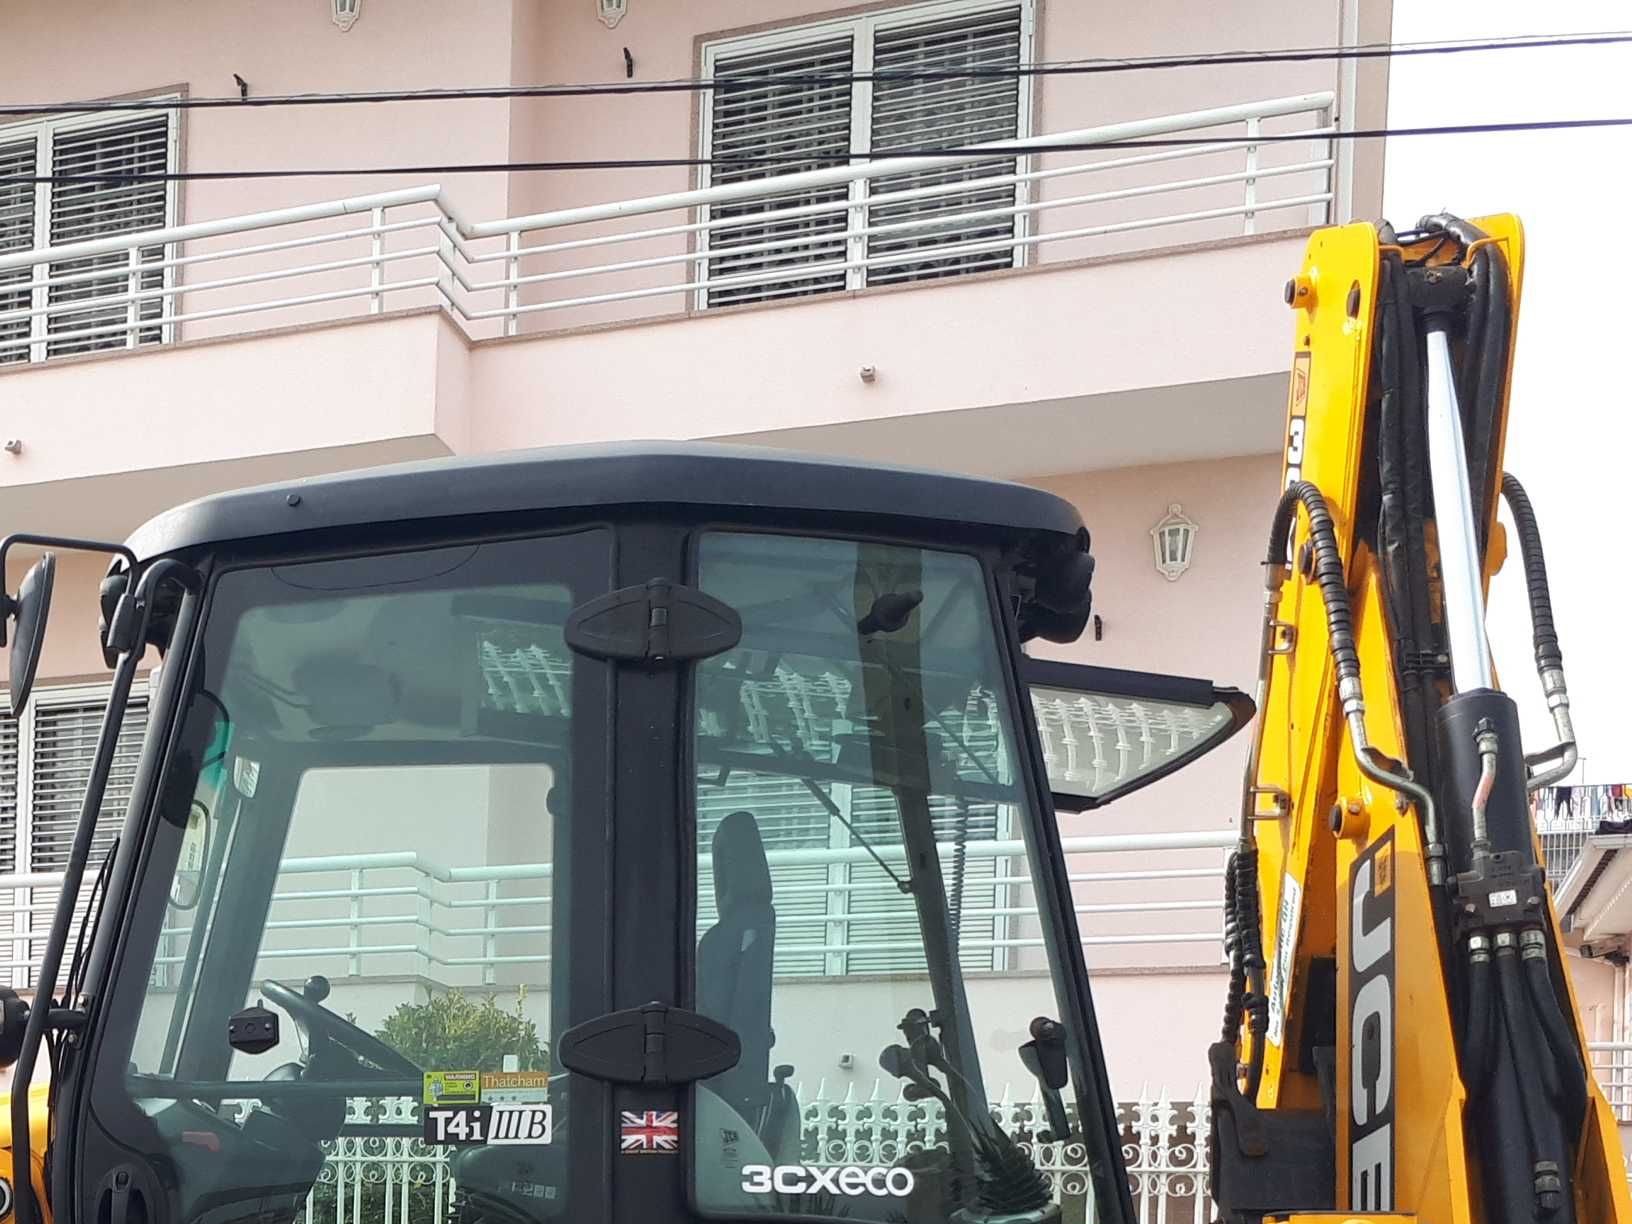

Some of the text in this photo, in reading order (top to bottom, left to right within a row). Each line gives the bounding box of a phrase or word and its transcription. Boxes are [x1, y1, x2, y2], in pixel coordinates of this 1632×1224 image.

[483, 1075, 546, 1088] Thatcham
[428, 1110, 548, 1141] T4i IIIB
